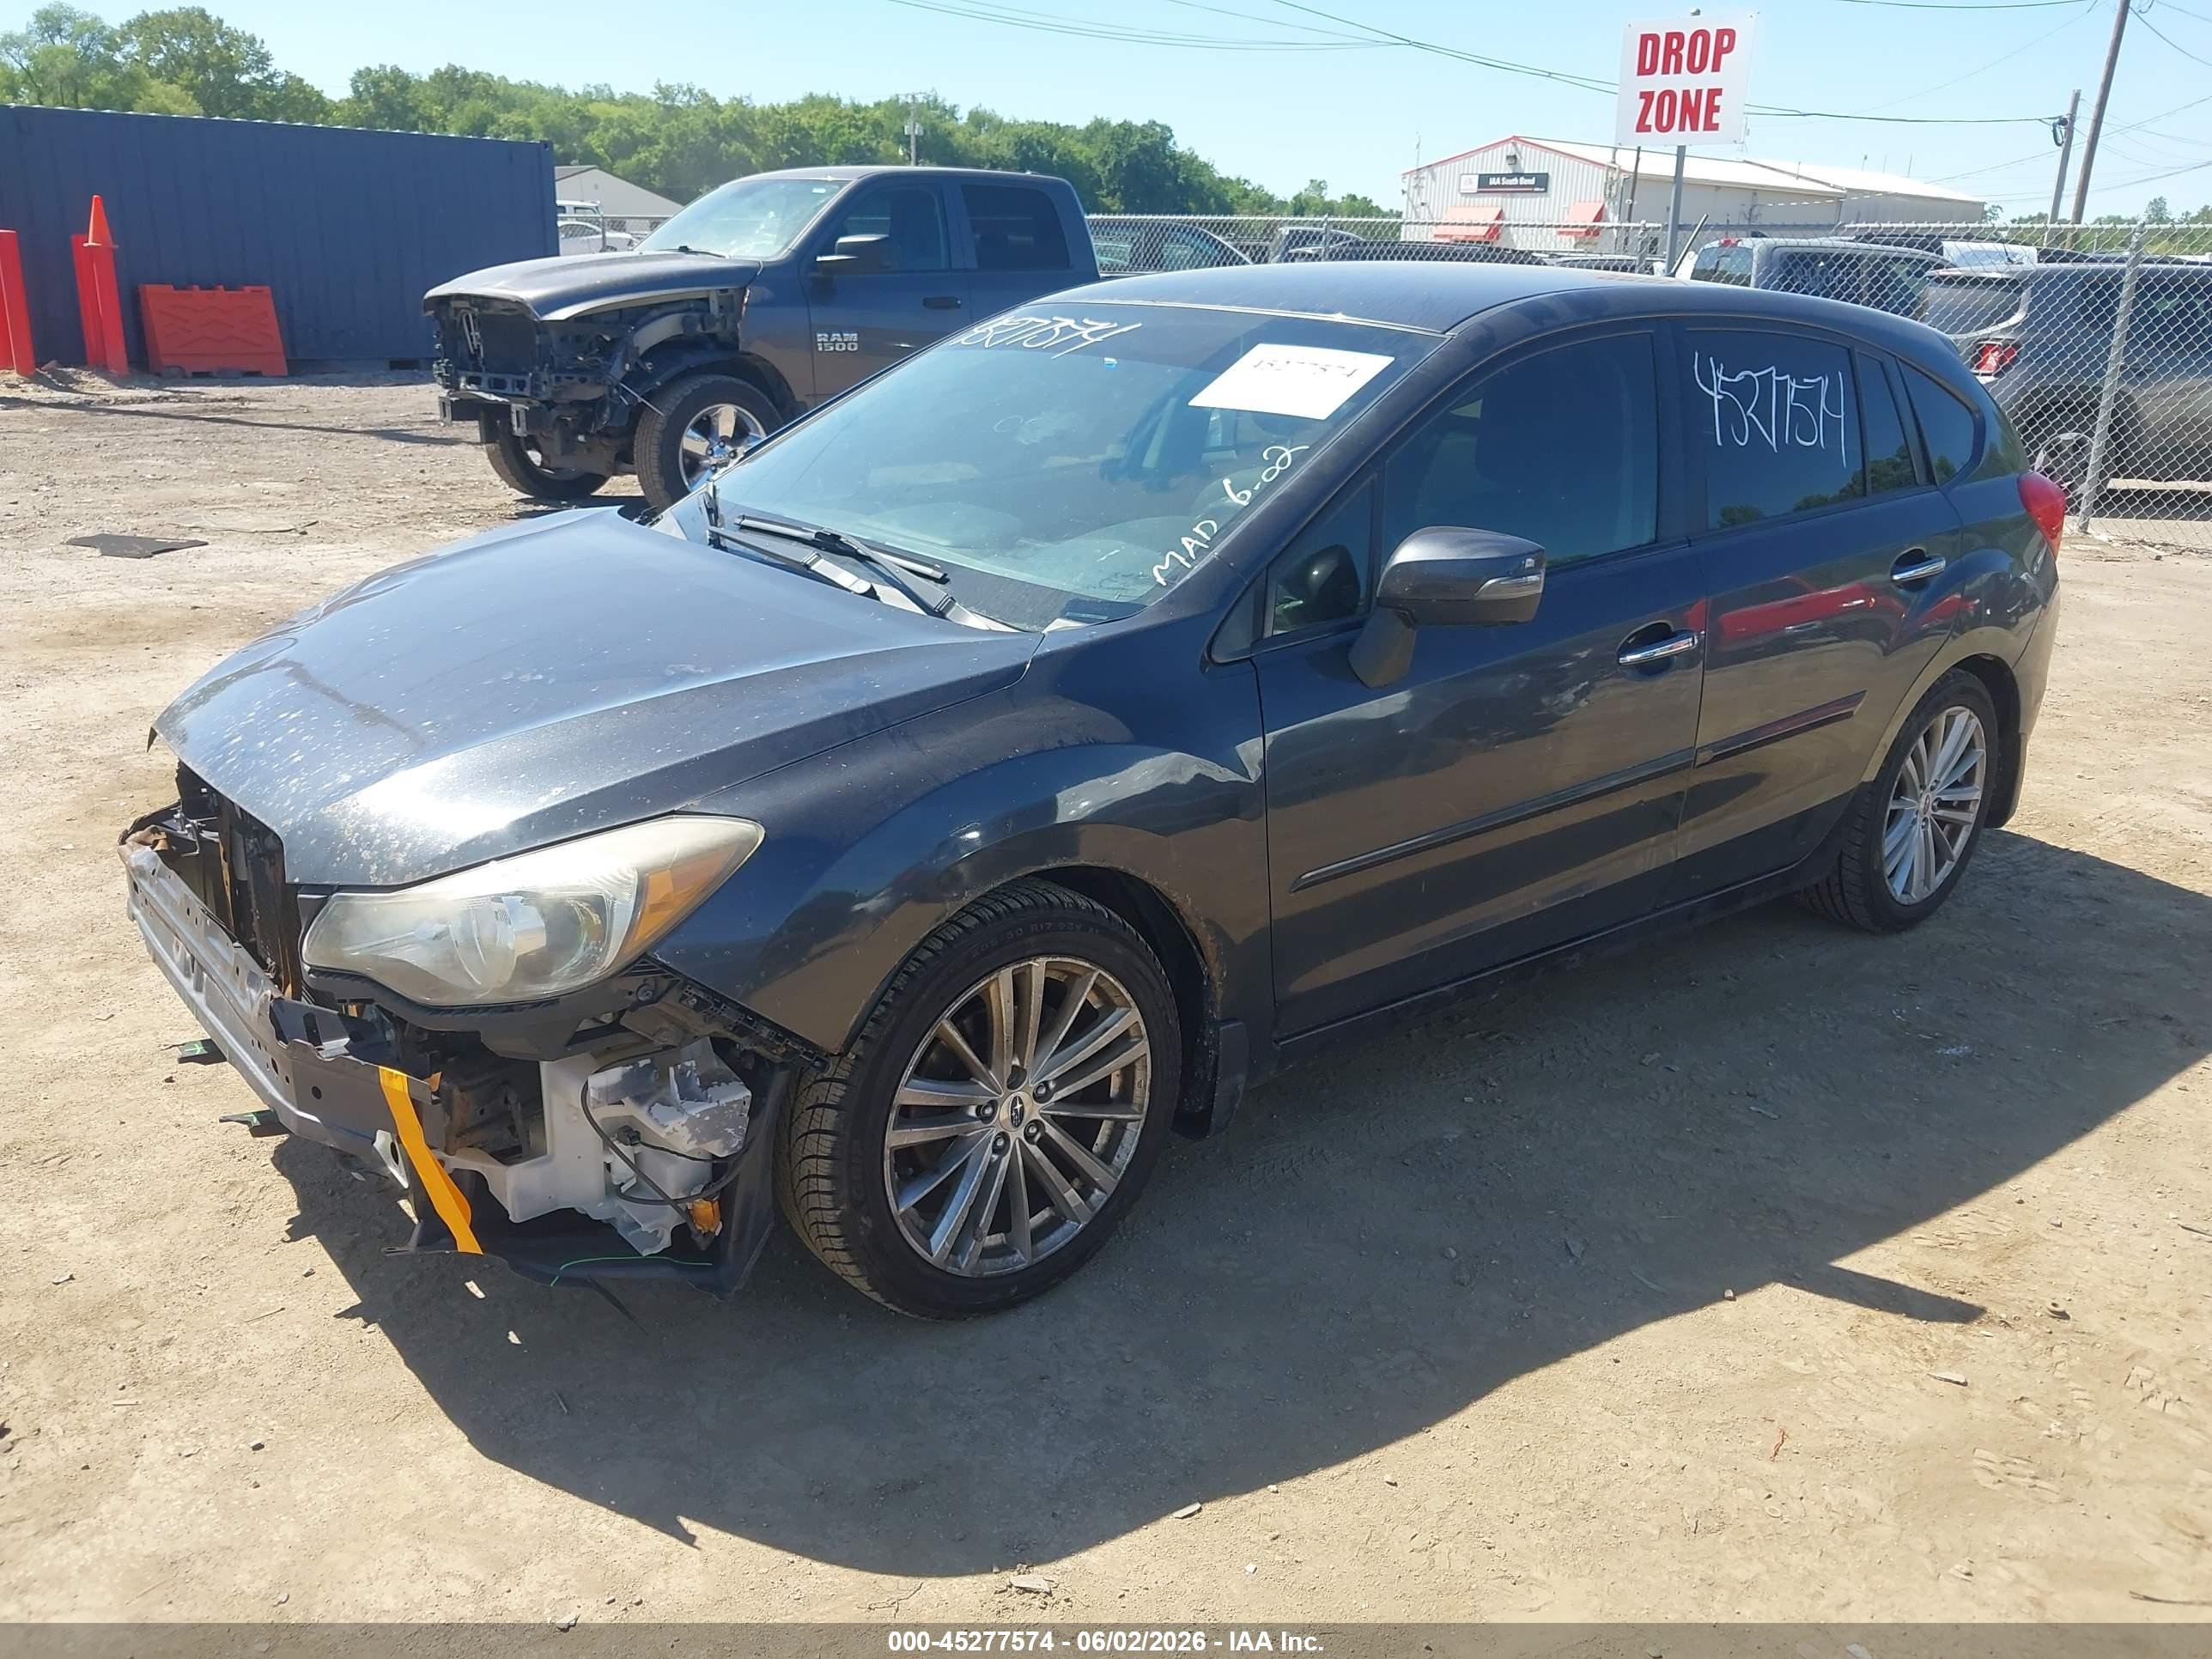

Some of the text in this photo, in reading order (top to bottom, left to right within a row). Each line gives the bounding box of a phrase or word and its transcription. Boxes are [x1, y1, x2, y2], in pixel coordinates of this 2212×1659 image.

[1636, 28, 1736, 76] DROP
[1635, 88, 1723, 133] ZONE
[817, 332, 859, 342] RAM
[817, 342, 859, 352] 1500
[1694, 350, 1846, 468] 45277574
[1152, 520, 1218, 587] MAD
